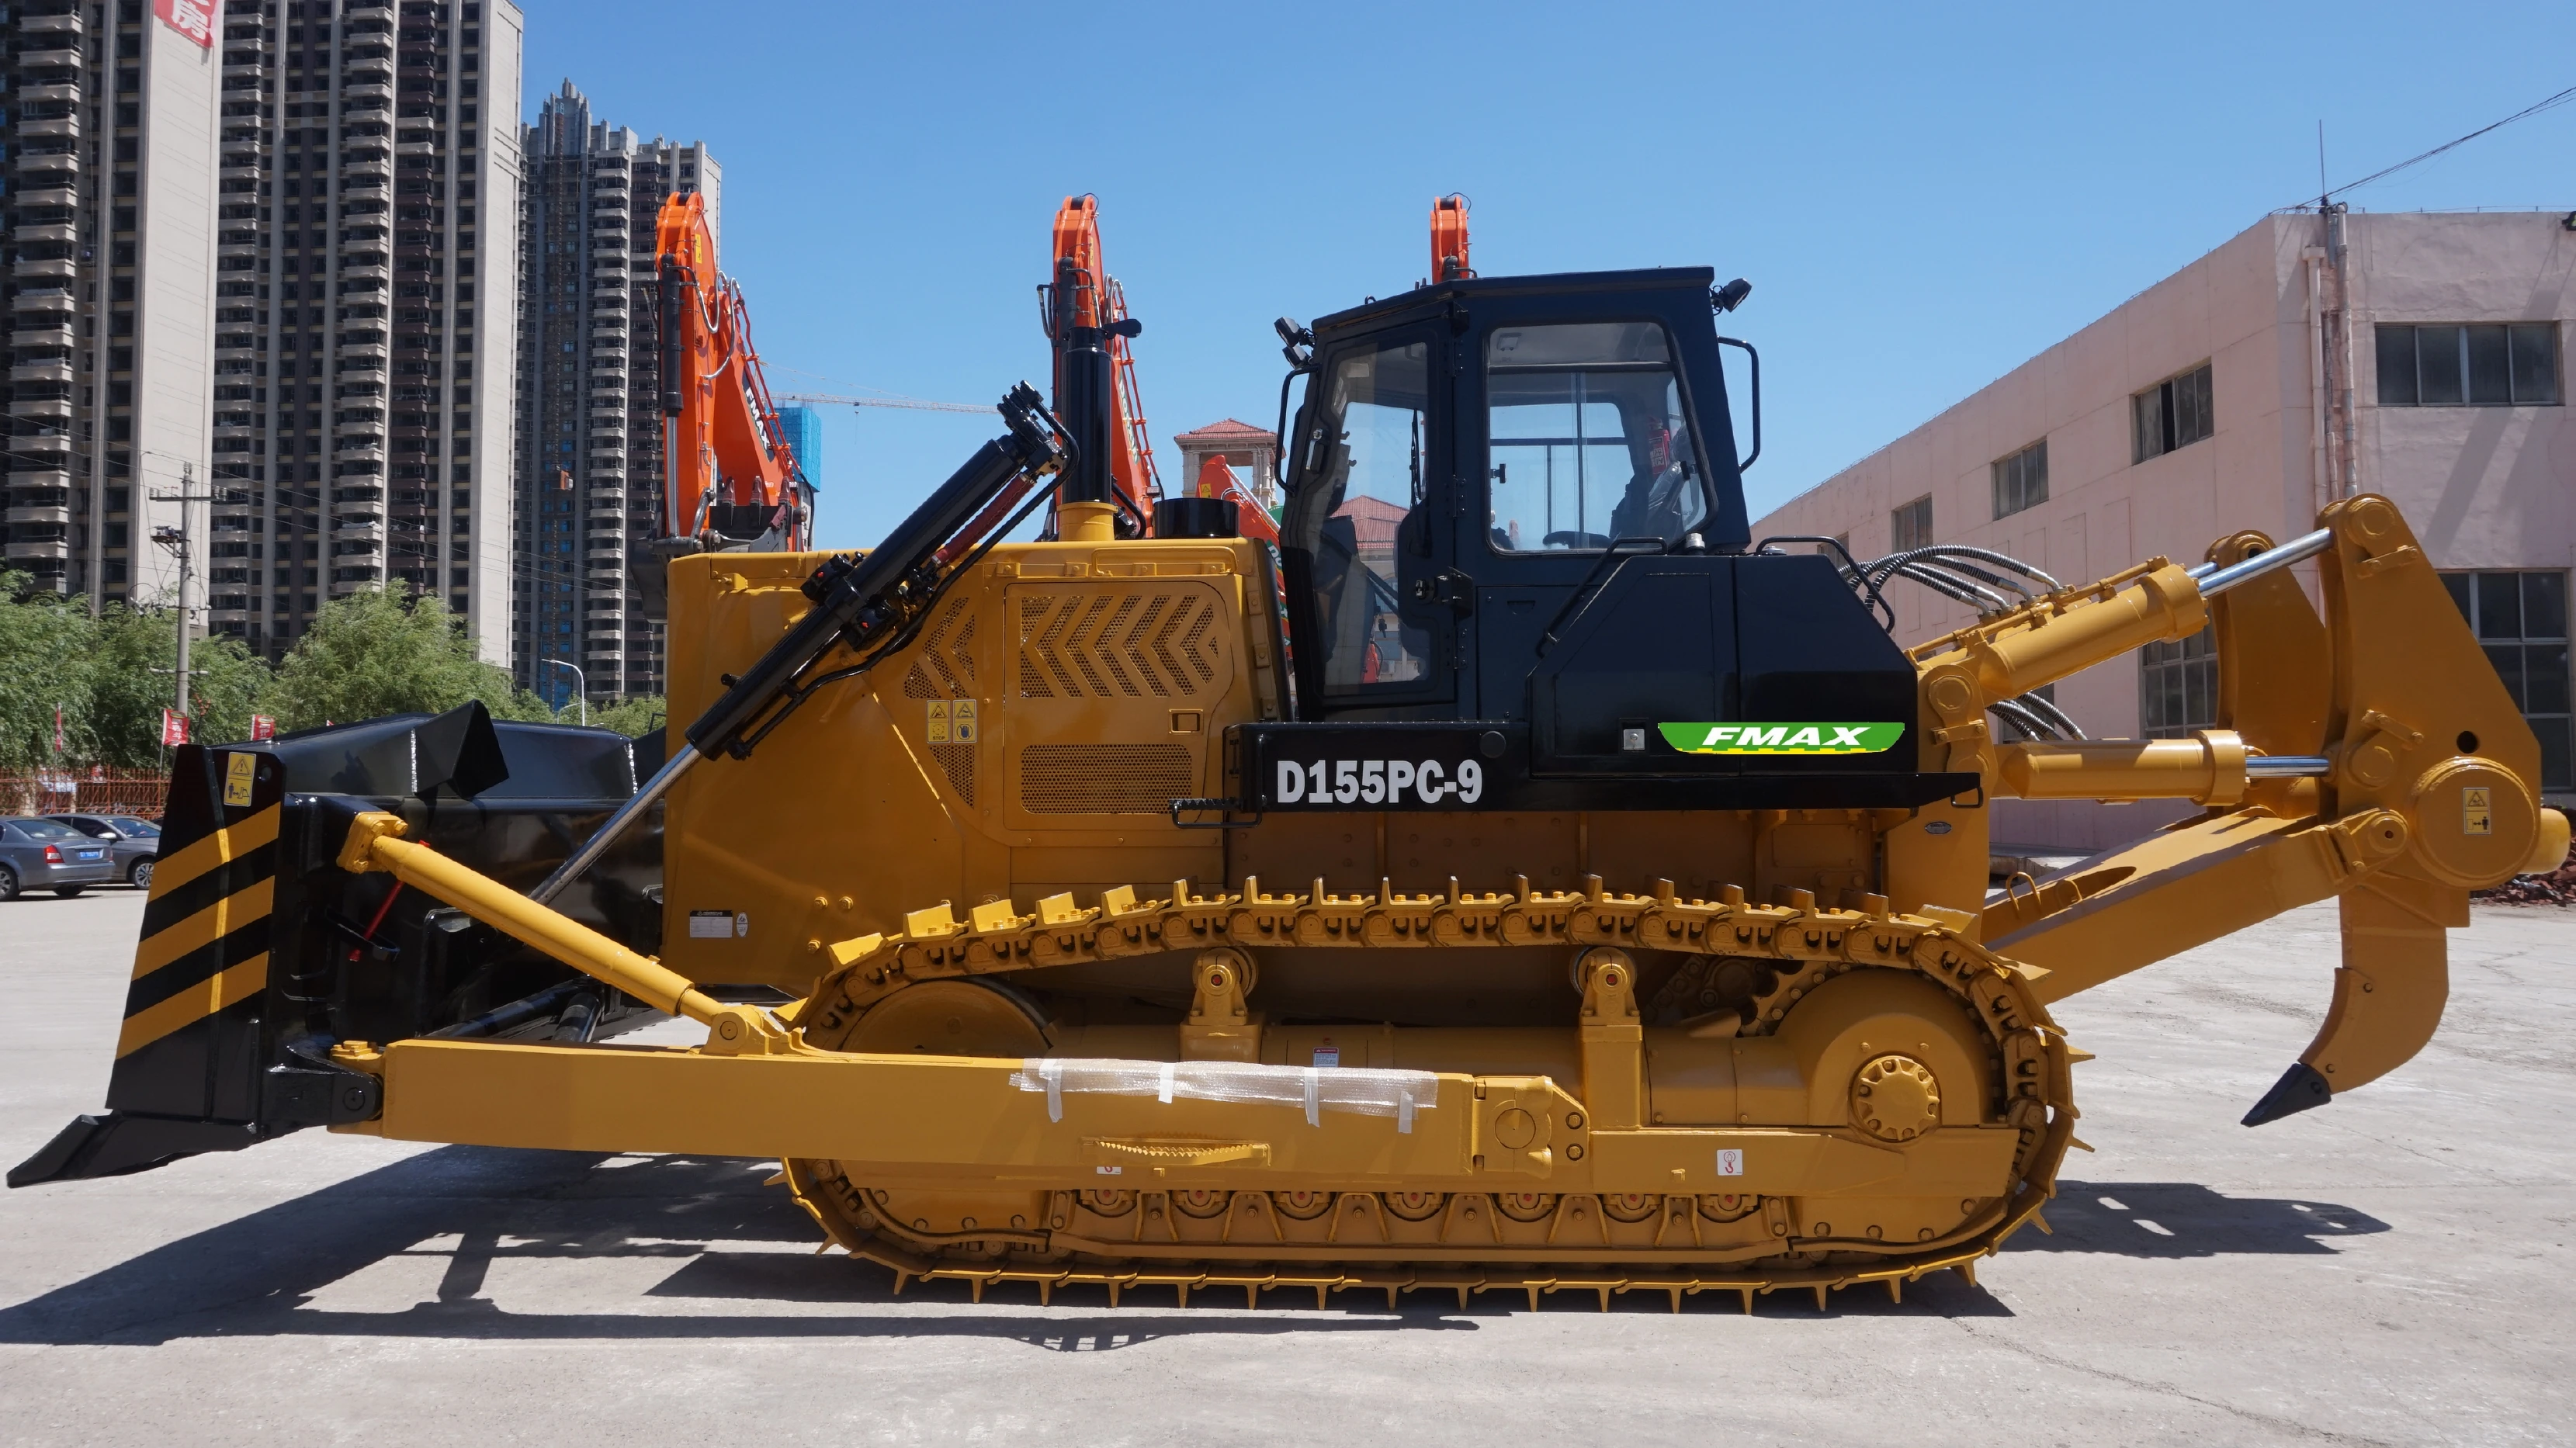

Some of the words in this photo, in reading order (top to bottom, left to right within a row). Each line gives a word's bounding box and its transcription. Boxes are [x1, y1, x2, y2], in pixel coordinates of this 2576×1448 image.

[746, 386, 770, 450] FMAX
[1701, 726, 1872, 746] FMAX
[1277, 759, 1483, 804] D155PC-9
